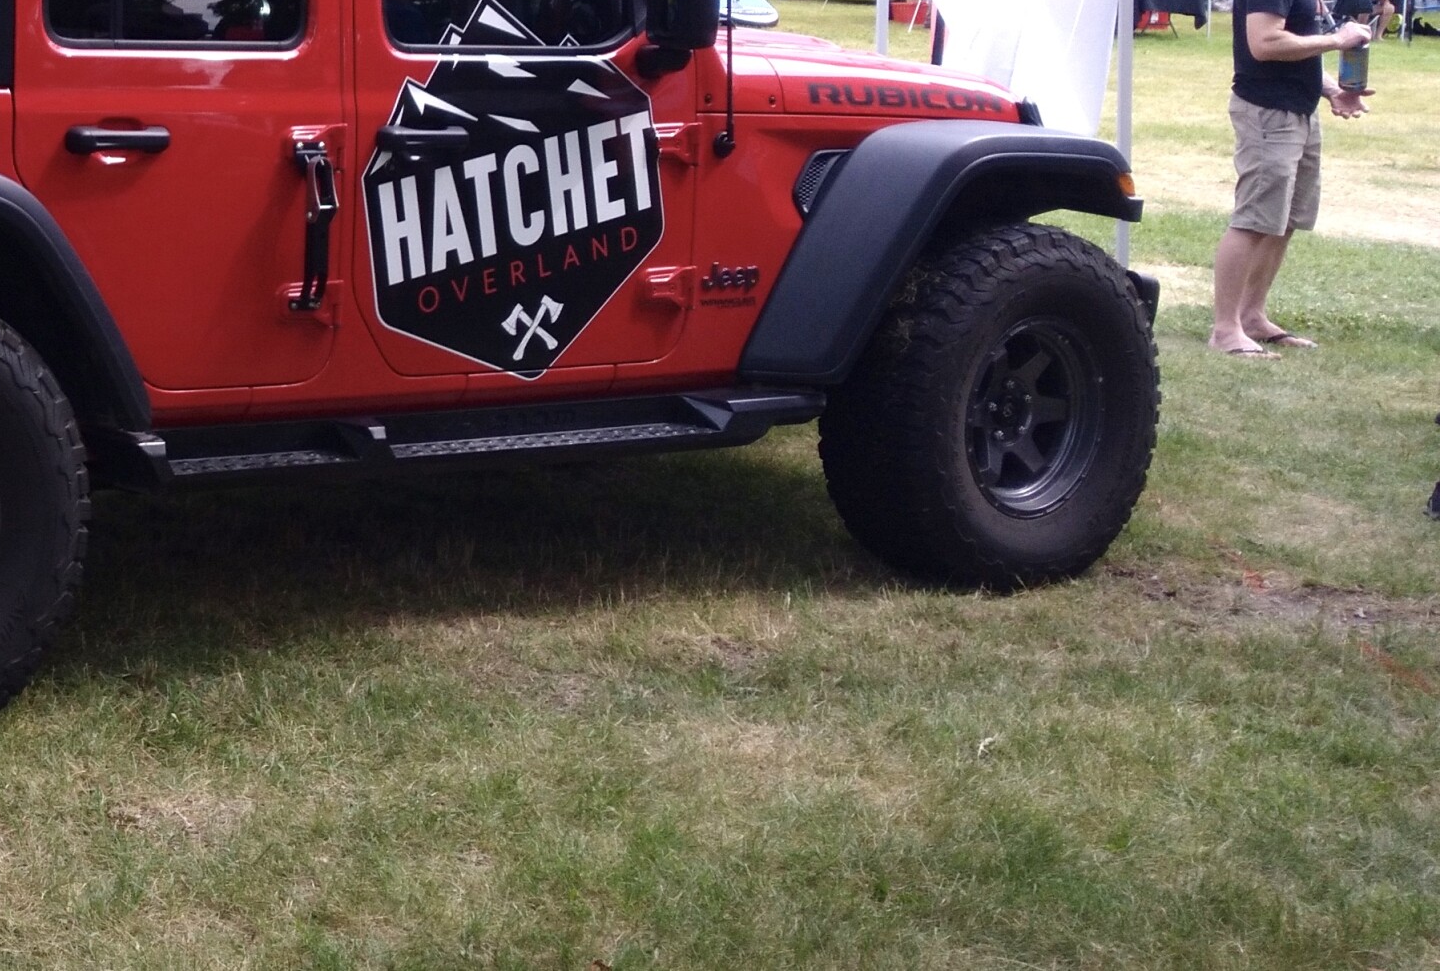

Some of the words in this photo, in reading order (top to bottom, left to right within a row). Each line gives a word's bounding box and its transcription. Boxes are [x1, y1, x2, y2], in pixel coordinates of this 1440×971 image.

[807, 82, 1002, 112] RUBICON
[378, 110, 652, 286] HATCHET
[418, 227, 638, 313] OVERLAND
[701, 261, 759, 293] Jeep
